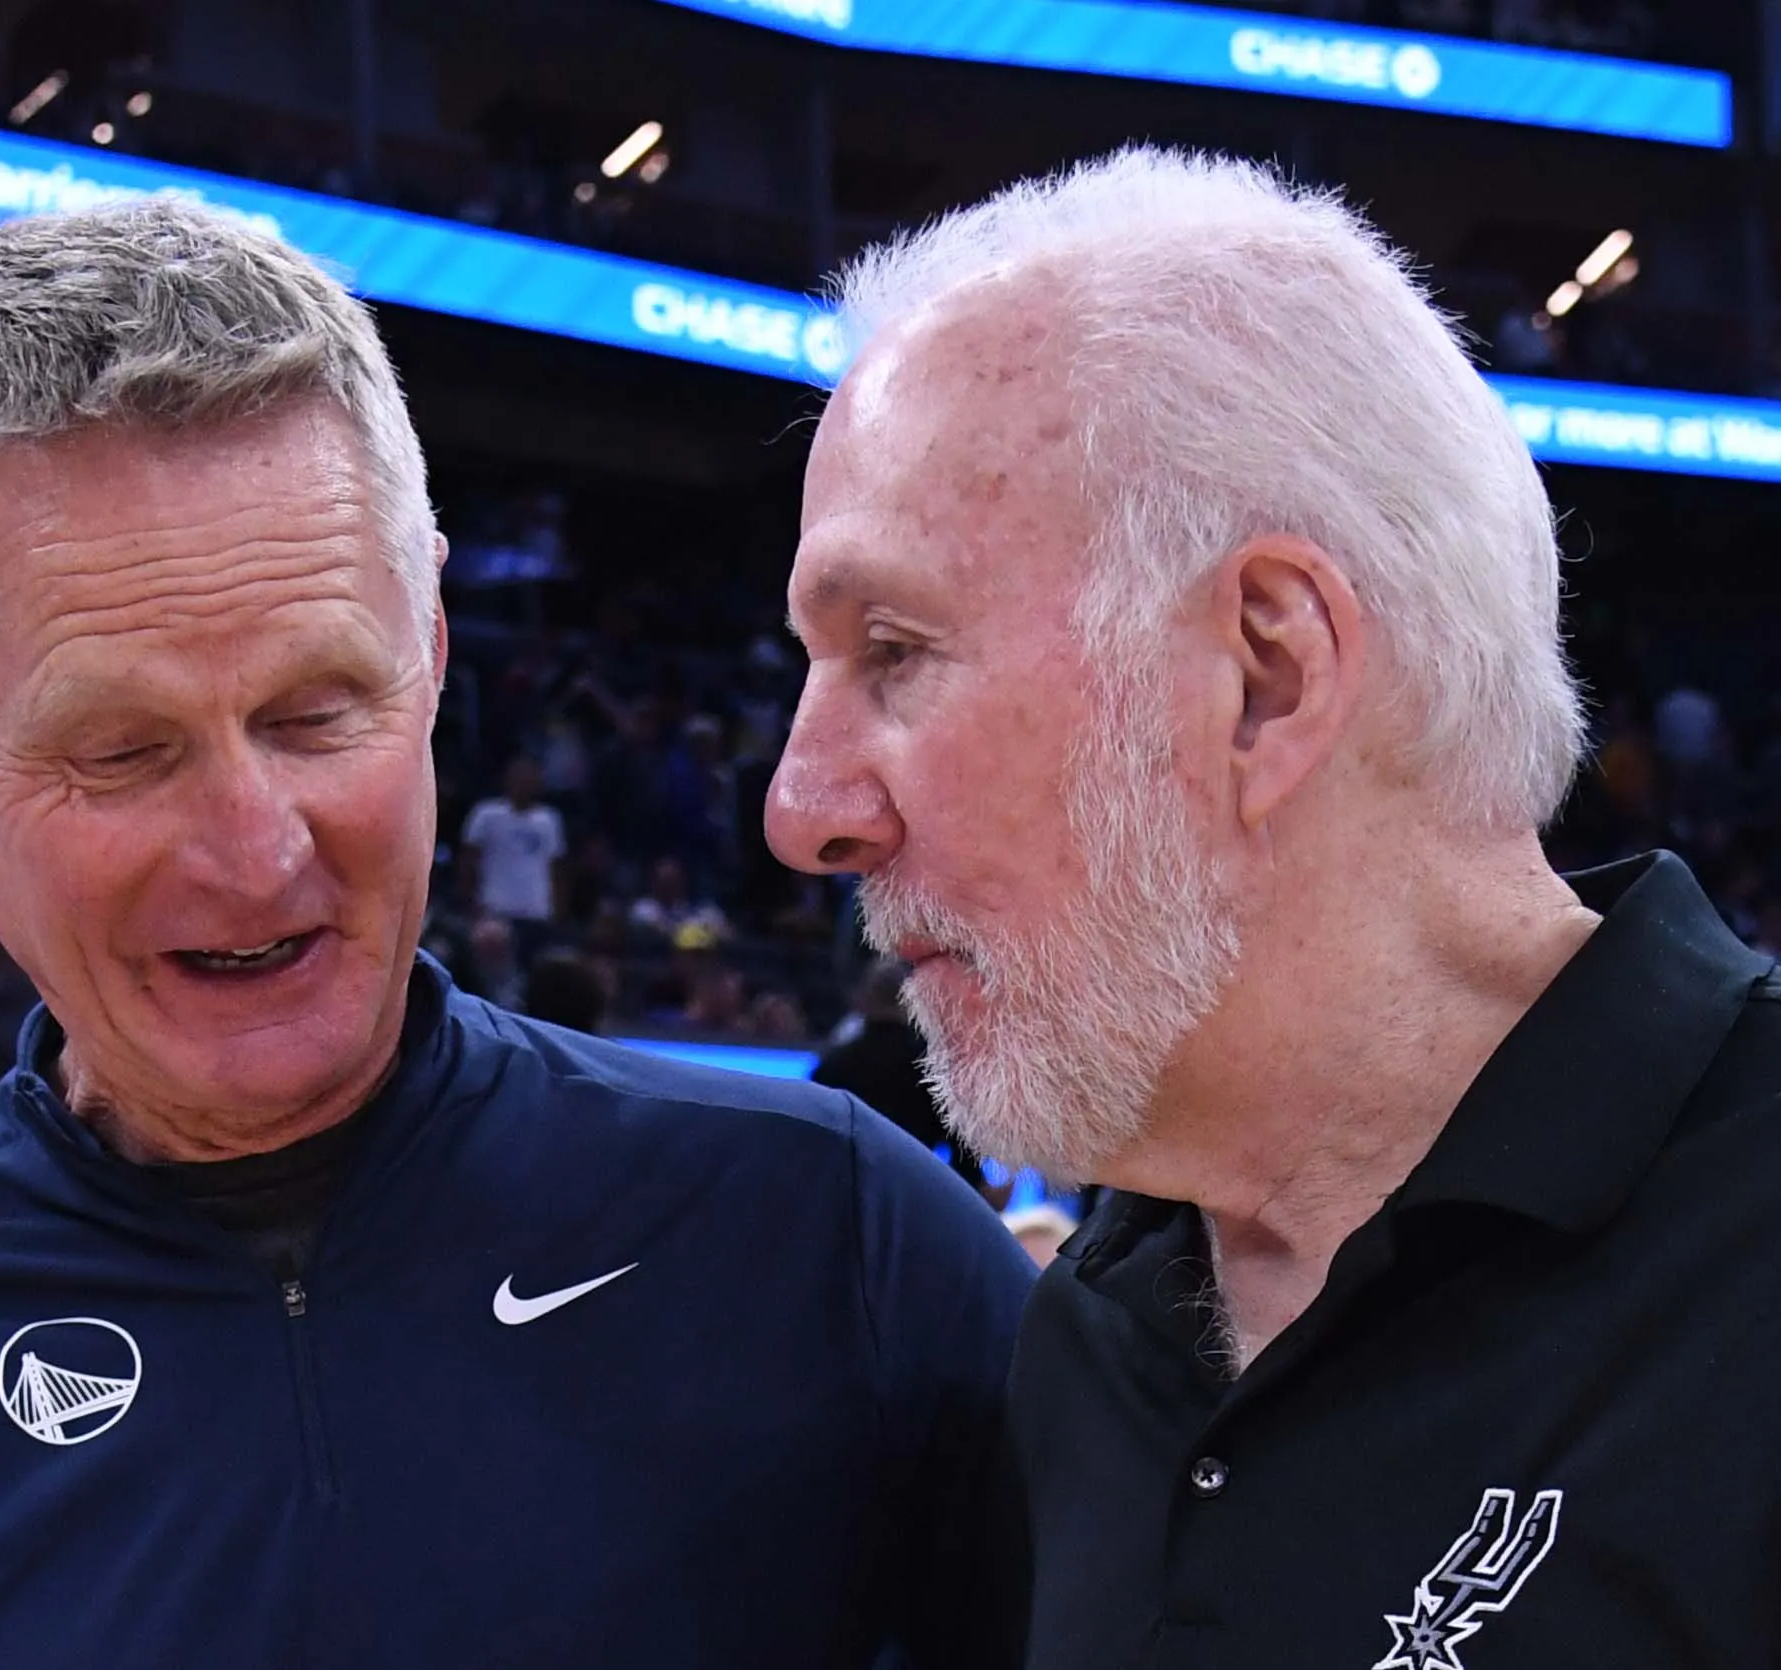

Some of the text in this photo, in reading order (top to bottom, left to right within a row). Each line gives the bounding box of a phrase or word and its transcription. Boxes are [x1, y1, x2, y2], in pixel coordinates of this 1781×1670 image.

[1231, 29, 1387, 90] CHASE
[632, 282, 798, 361] CHASE
[1555, 405, 1664, 455] more
[1666, 415, 1712, 459] at
